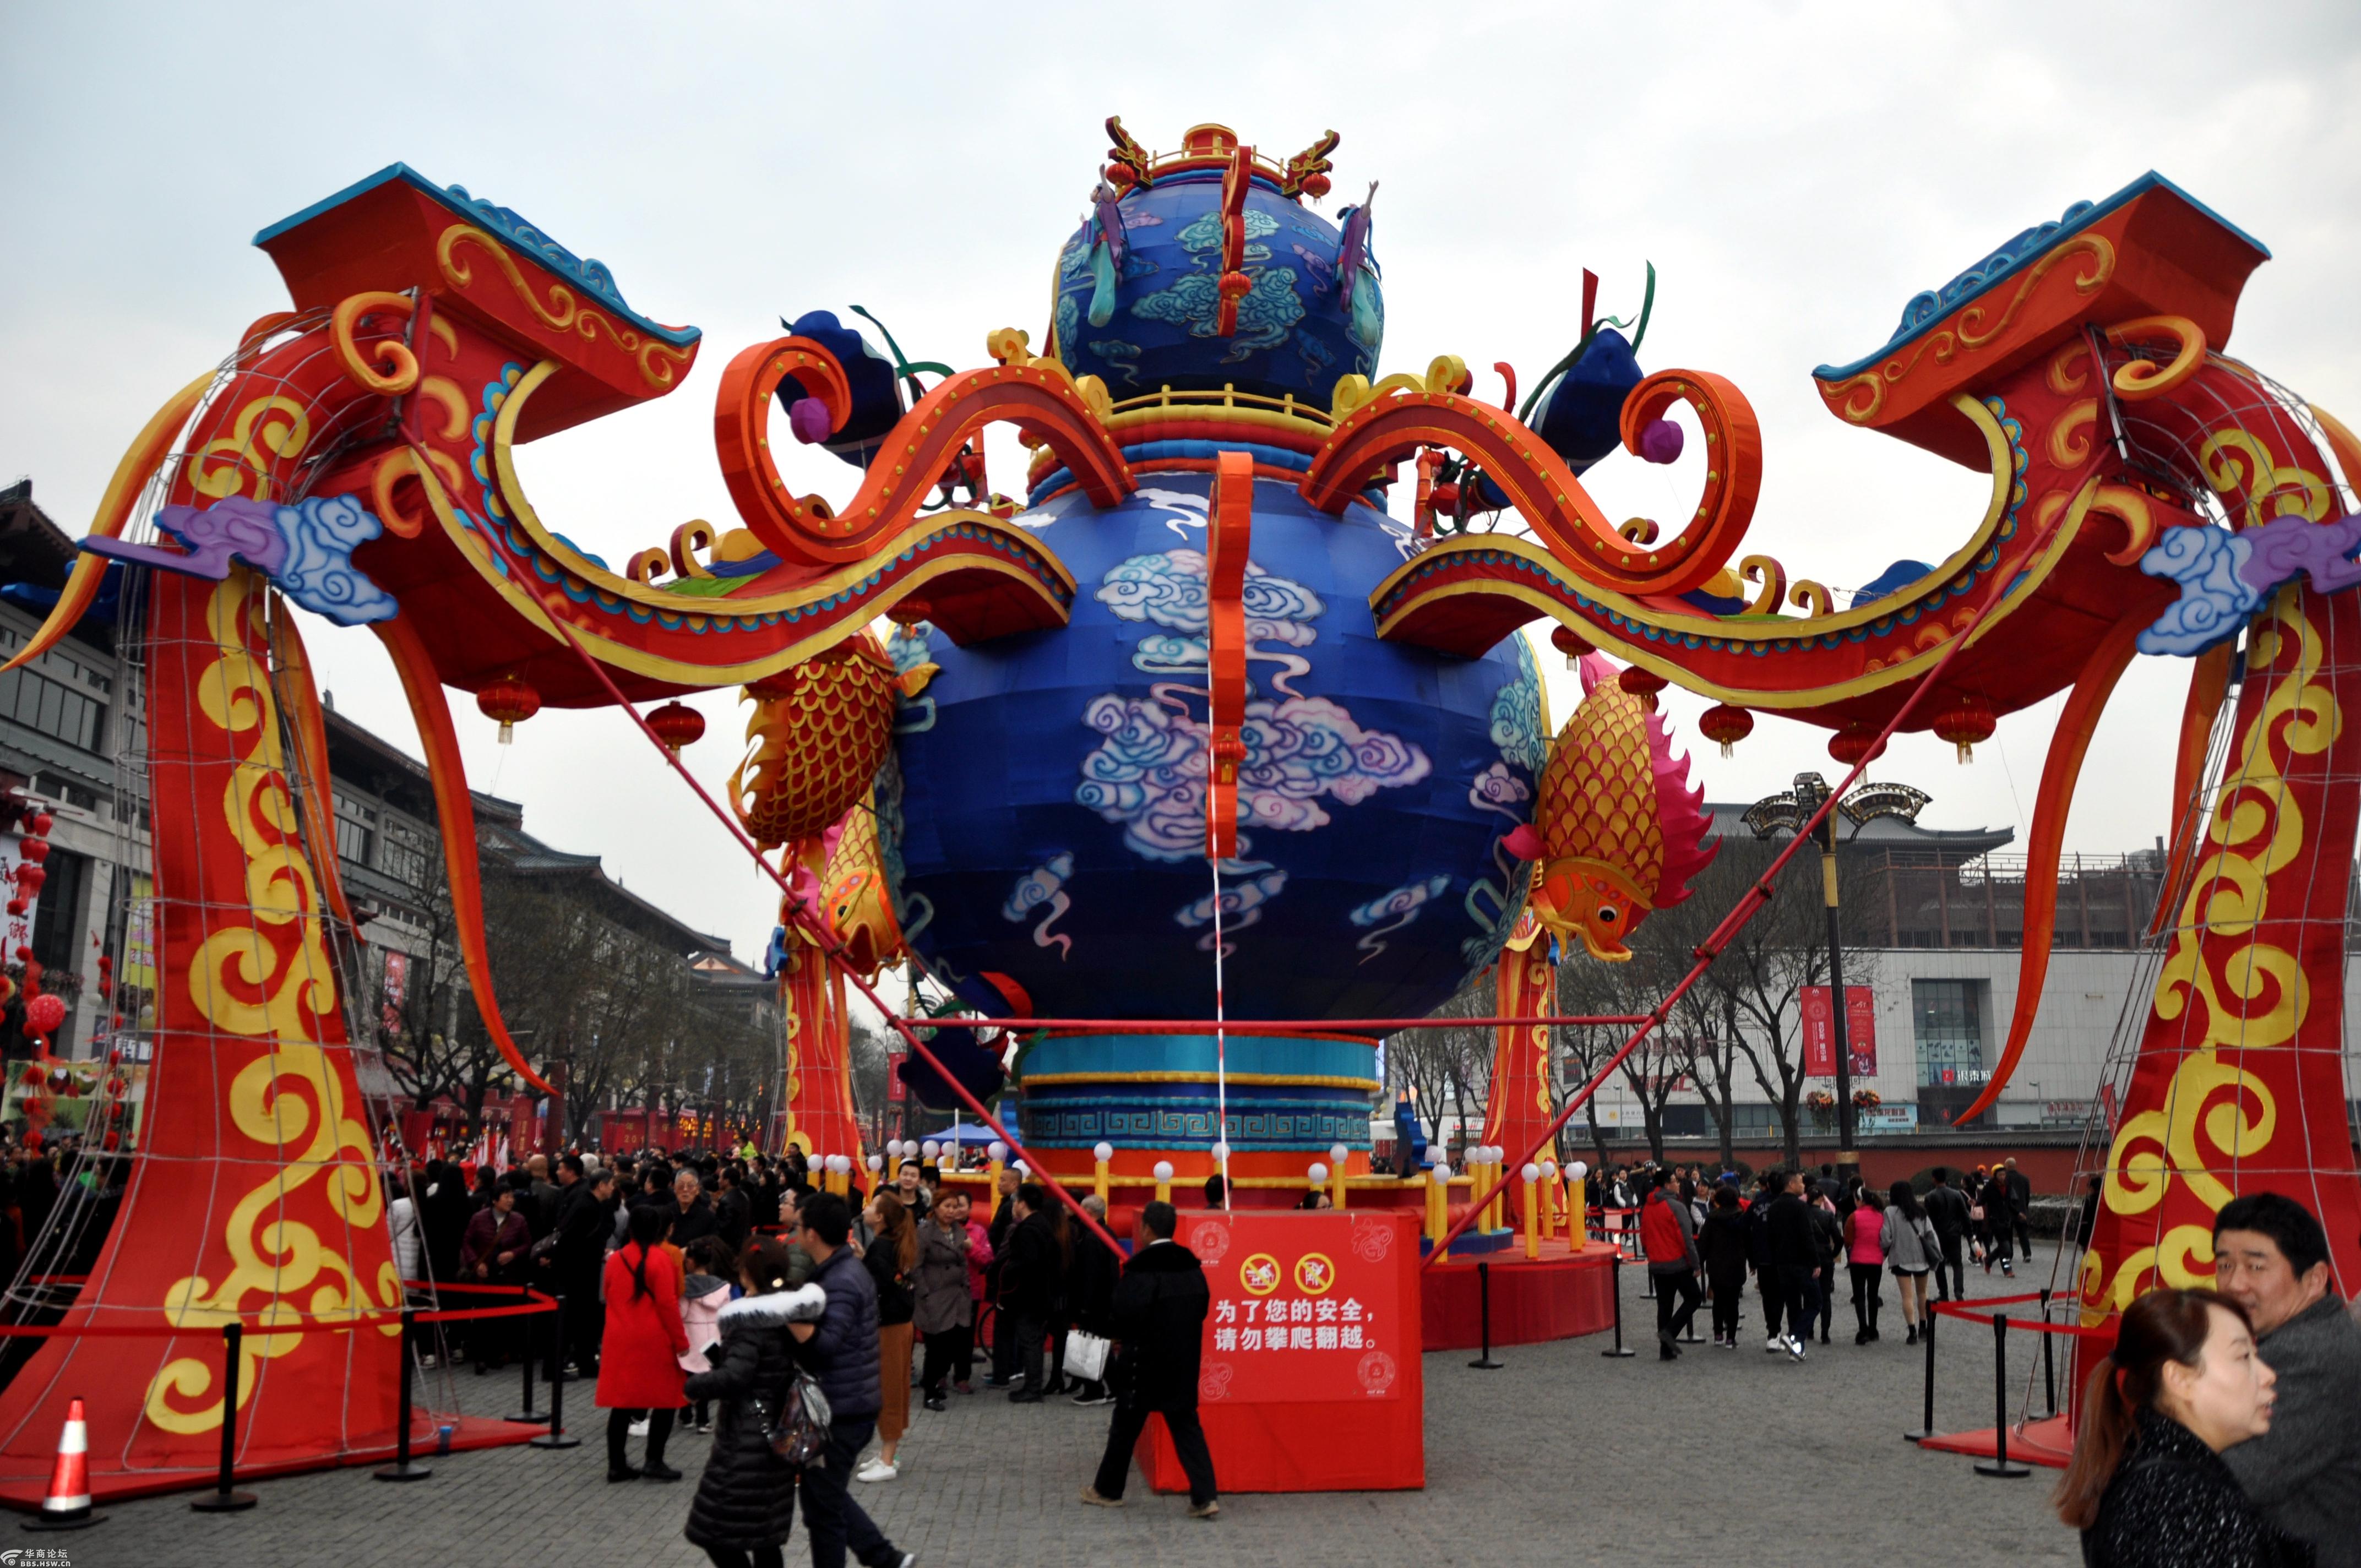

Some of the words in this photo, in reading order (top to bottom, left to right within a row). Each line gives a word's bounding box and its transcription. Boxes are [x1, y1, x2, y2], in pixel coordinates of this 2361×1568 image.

[1215, 1297, 1373, 1323] 为了您的安全，
[1214, 1325, 1375, 1351] 请勿攀爬翻越。
